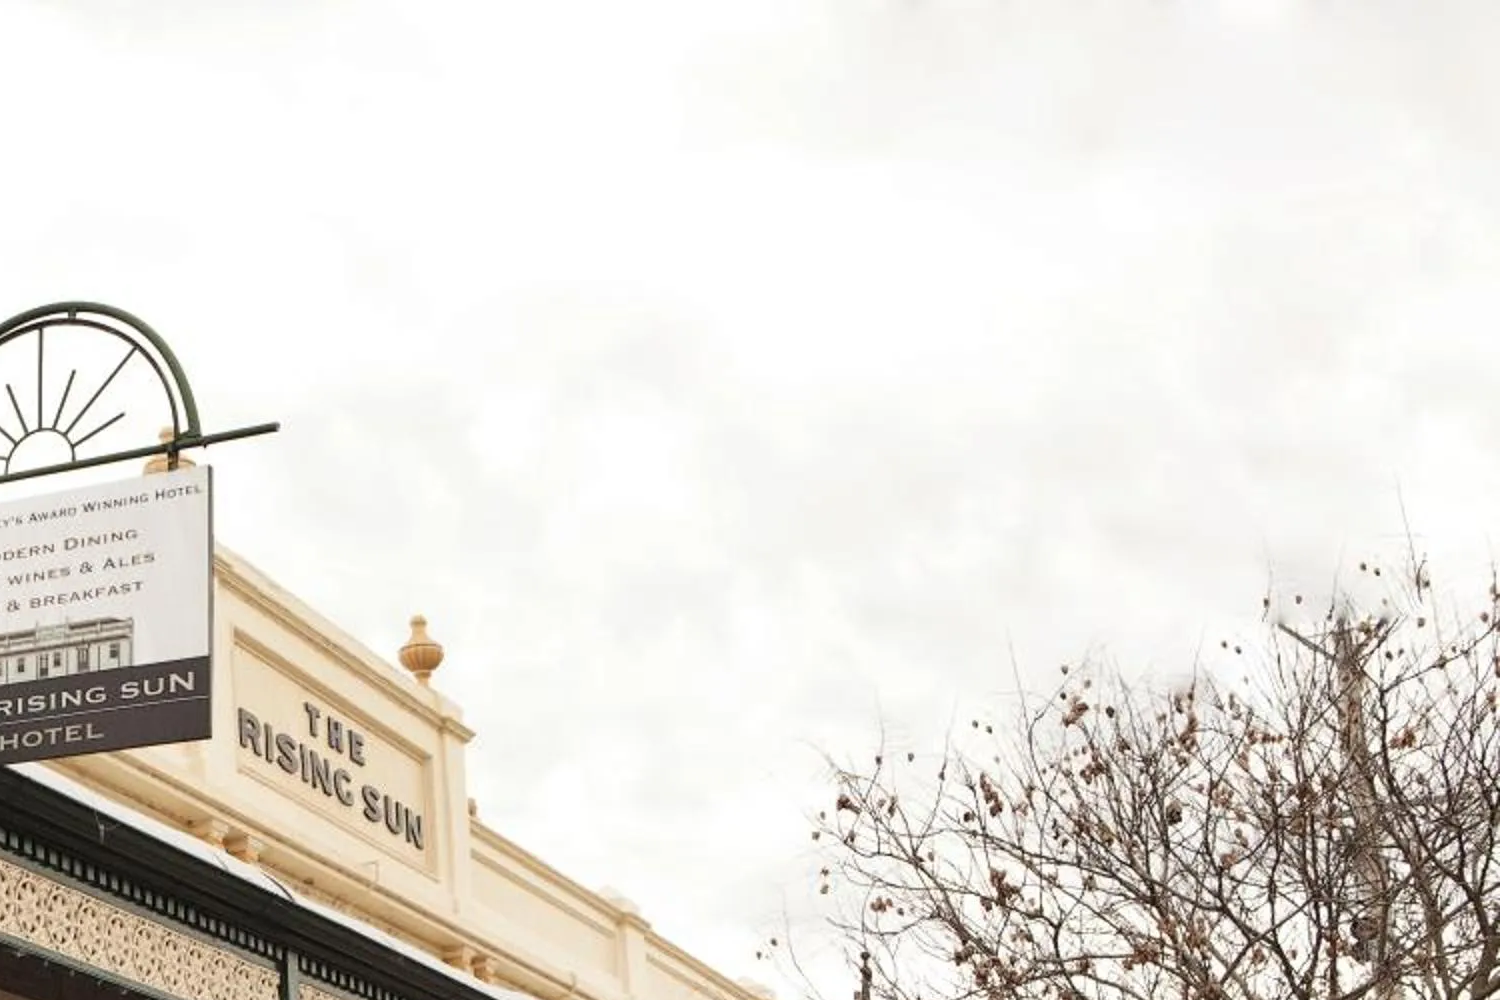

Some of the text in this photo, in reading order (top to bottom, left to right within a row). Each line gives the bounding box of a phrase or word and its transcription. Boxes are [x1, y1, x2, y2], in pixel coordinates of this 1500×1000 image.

[29, 506, 77, 523] AWARD
[82, 492, 149, 514] WINNING
[155, 484, 202, 501] HOTEL
[63, 529, 139, 552] DINING
[7, 566, 71, 586] WINES
[79, 561, 93, 575] &
[102, 552, 156, 571] ALES
[7, 599, 21, 613] &
[29, 581, 145, 609] BREAKFAST
[120, 671, 195, 699] SUN
[0, 722, 104, 751] HOTEL
[304, 701, 365, 767] THE
[237, 707, 424, 850] RISING SUN
